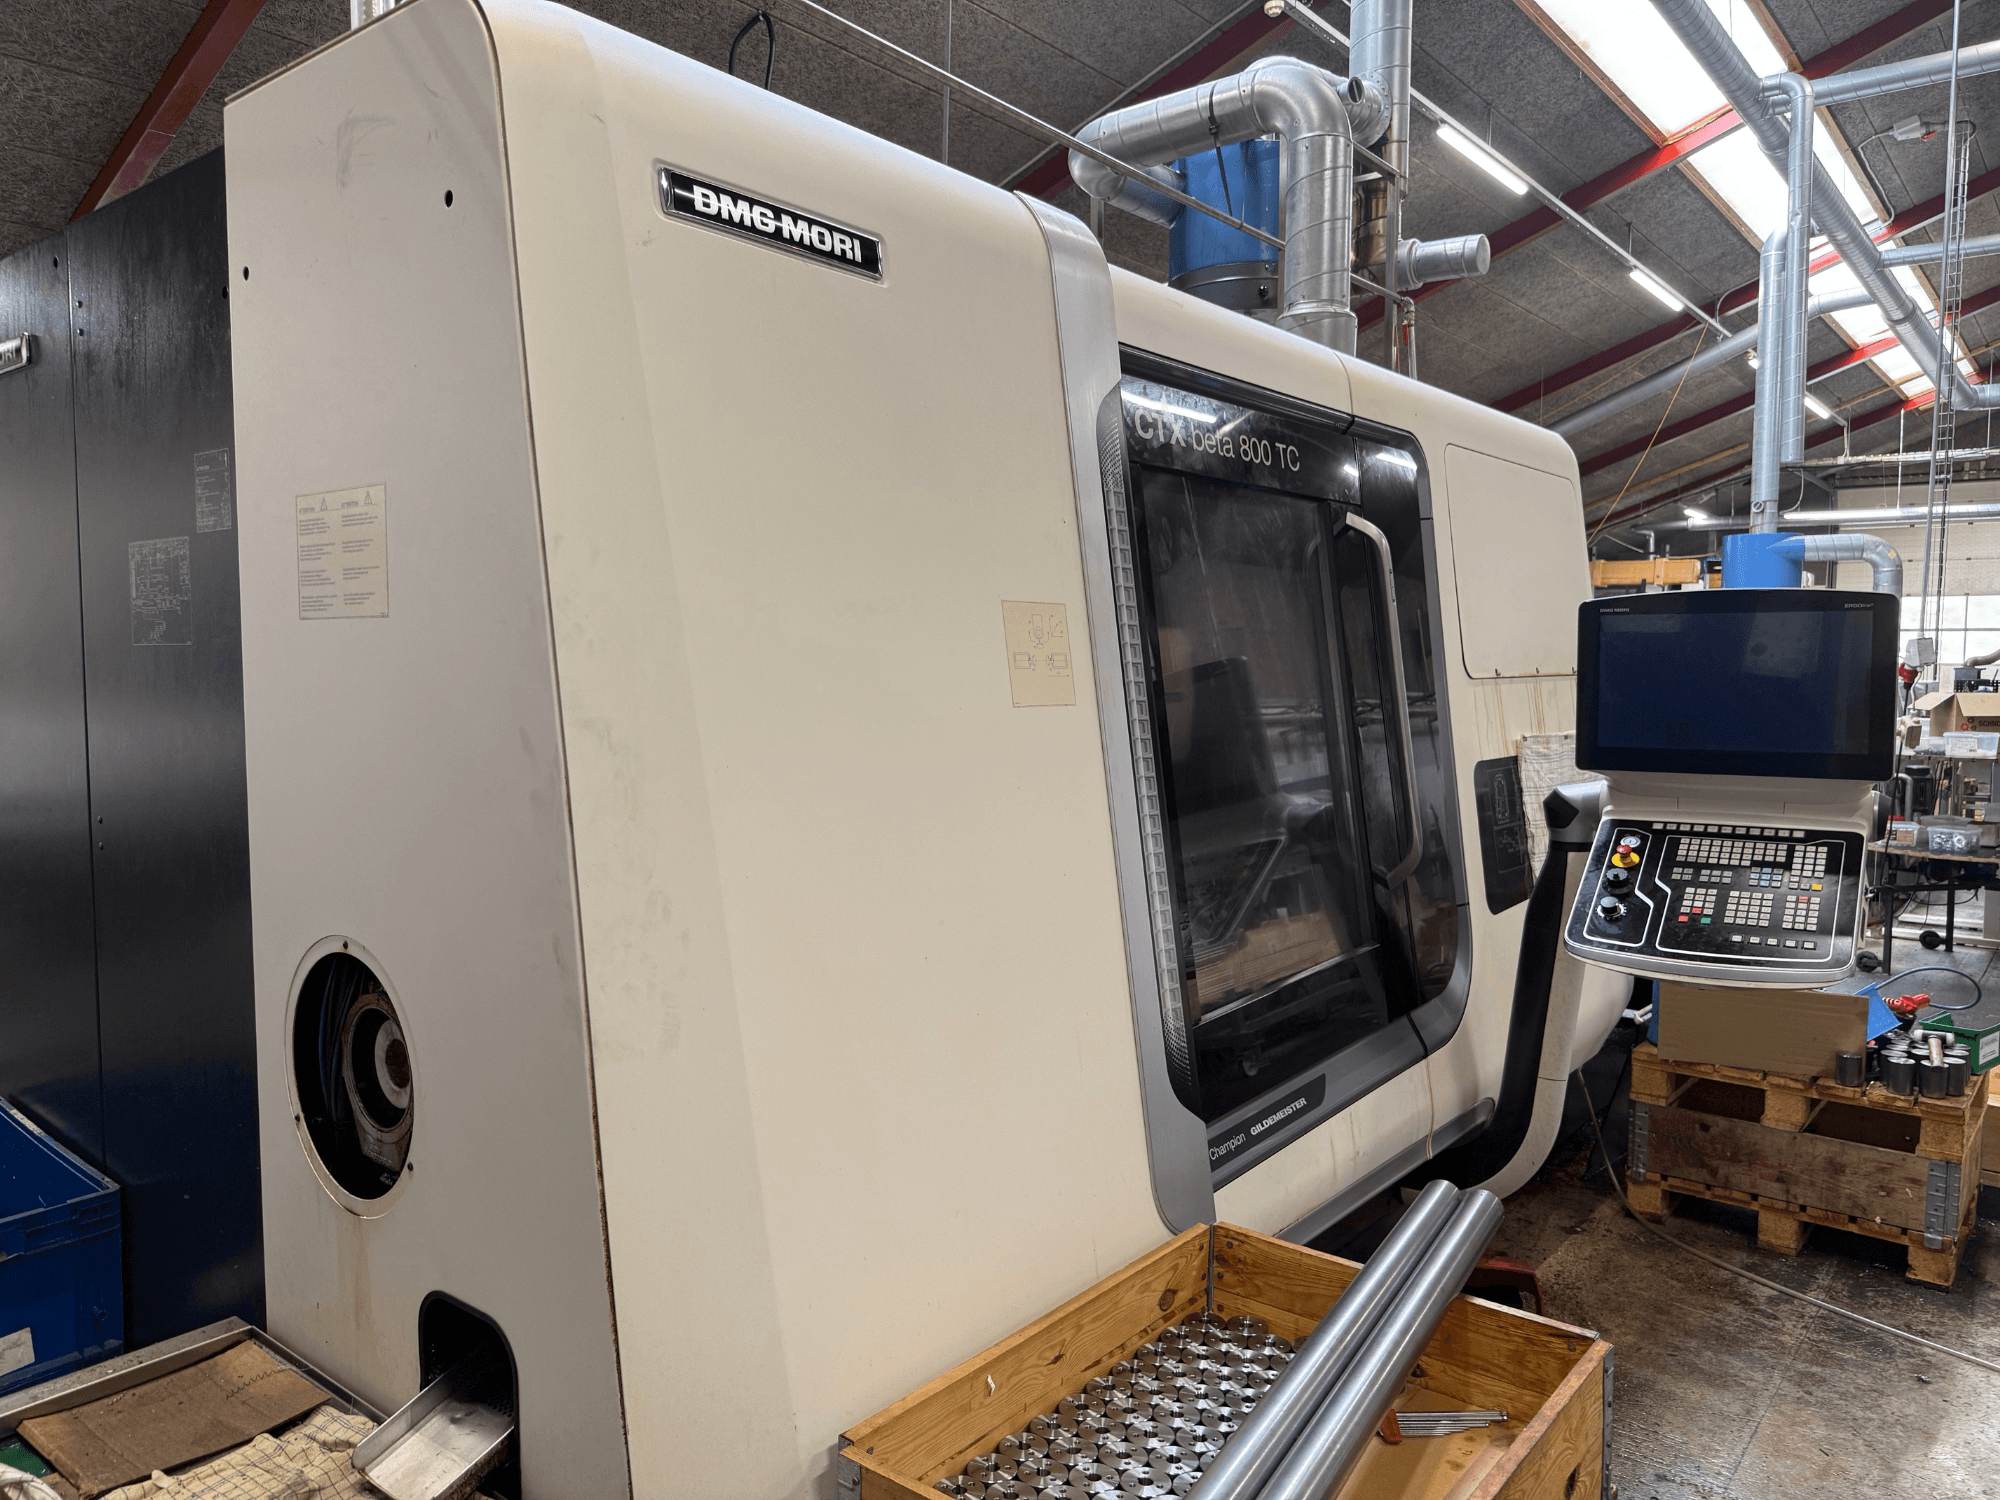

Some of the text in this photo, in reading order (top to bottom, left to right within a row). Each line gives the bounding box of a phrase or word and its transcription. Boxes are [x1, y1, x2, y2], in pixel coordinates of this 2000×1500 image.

[693, 184, 862, 263] DMG MORI
[1134, 407, 1301, 472] CTX beta 800 TC
[1209, 1097, 1307, 1160] Champion GILDEMEISTER
